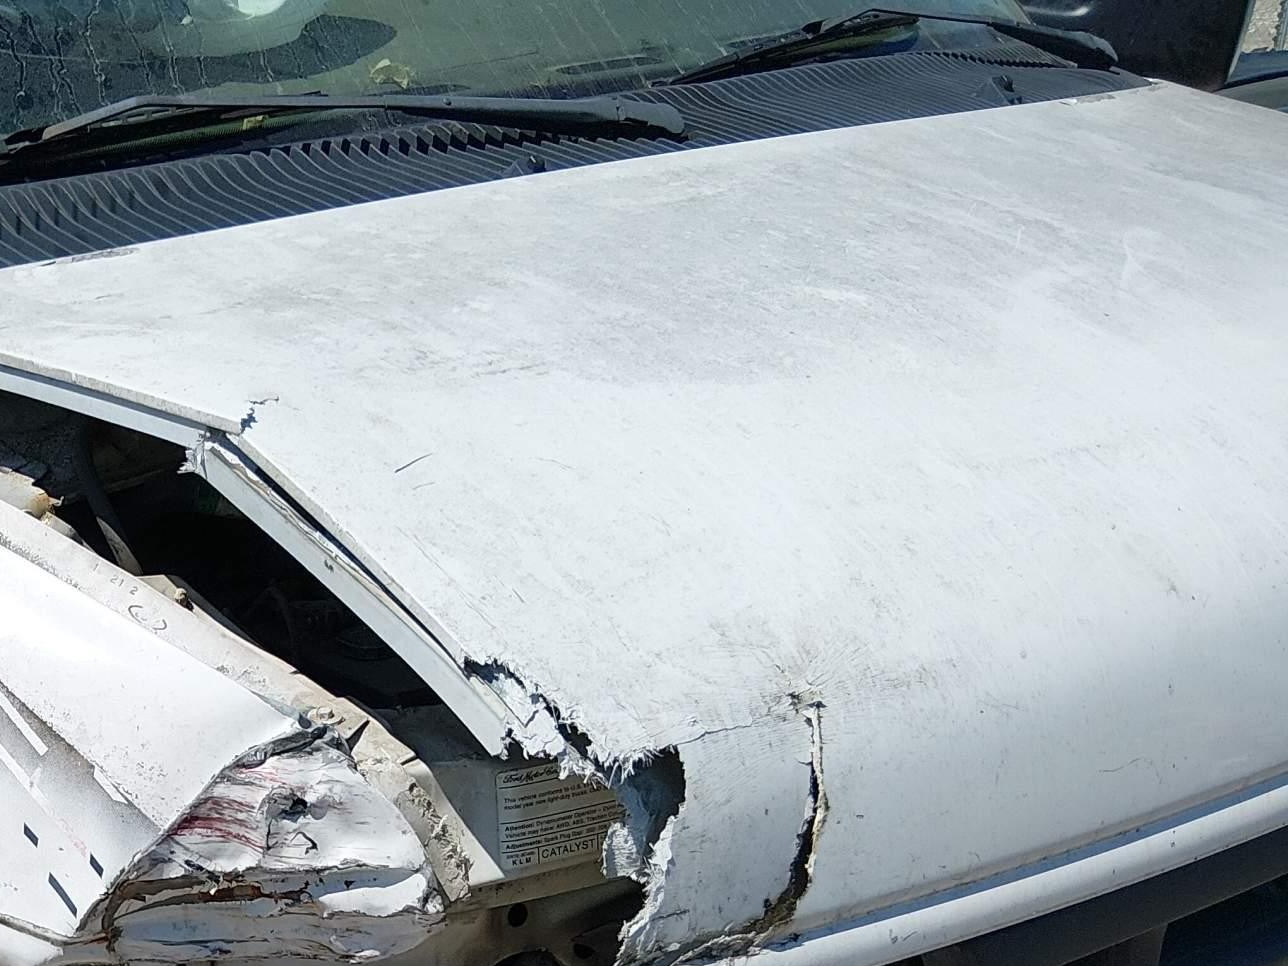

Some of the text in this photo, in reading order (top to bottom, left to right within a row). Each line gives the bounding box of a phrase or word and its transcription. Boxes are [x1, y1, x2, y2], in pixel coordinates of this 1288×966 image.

[505, 821, 535, 832] Attention:
[505, 831, 527, 839] Vehicle
[505, 839, 543, 850] Adjustments:
[541, 838, 597, 858] CATALYST
